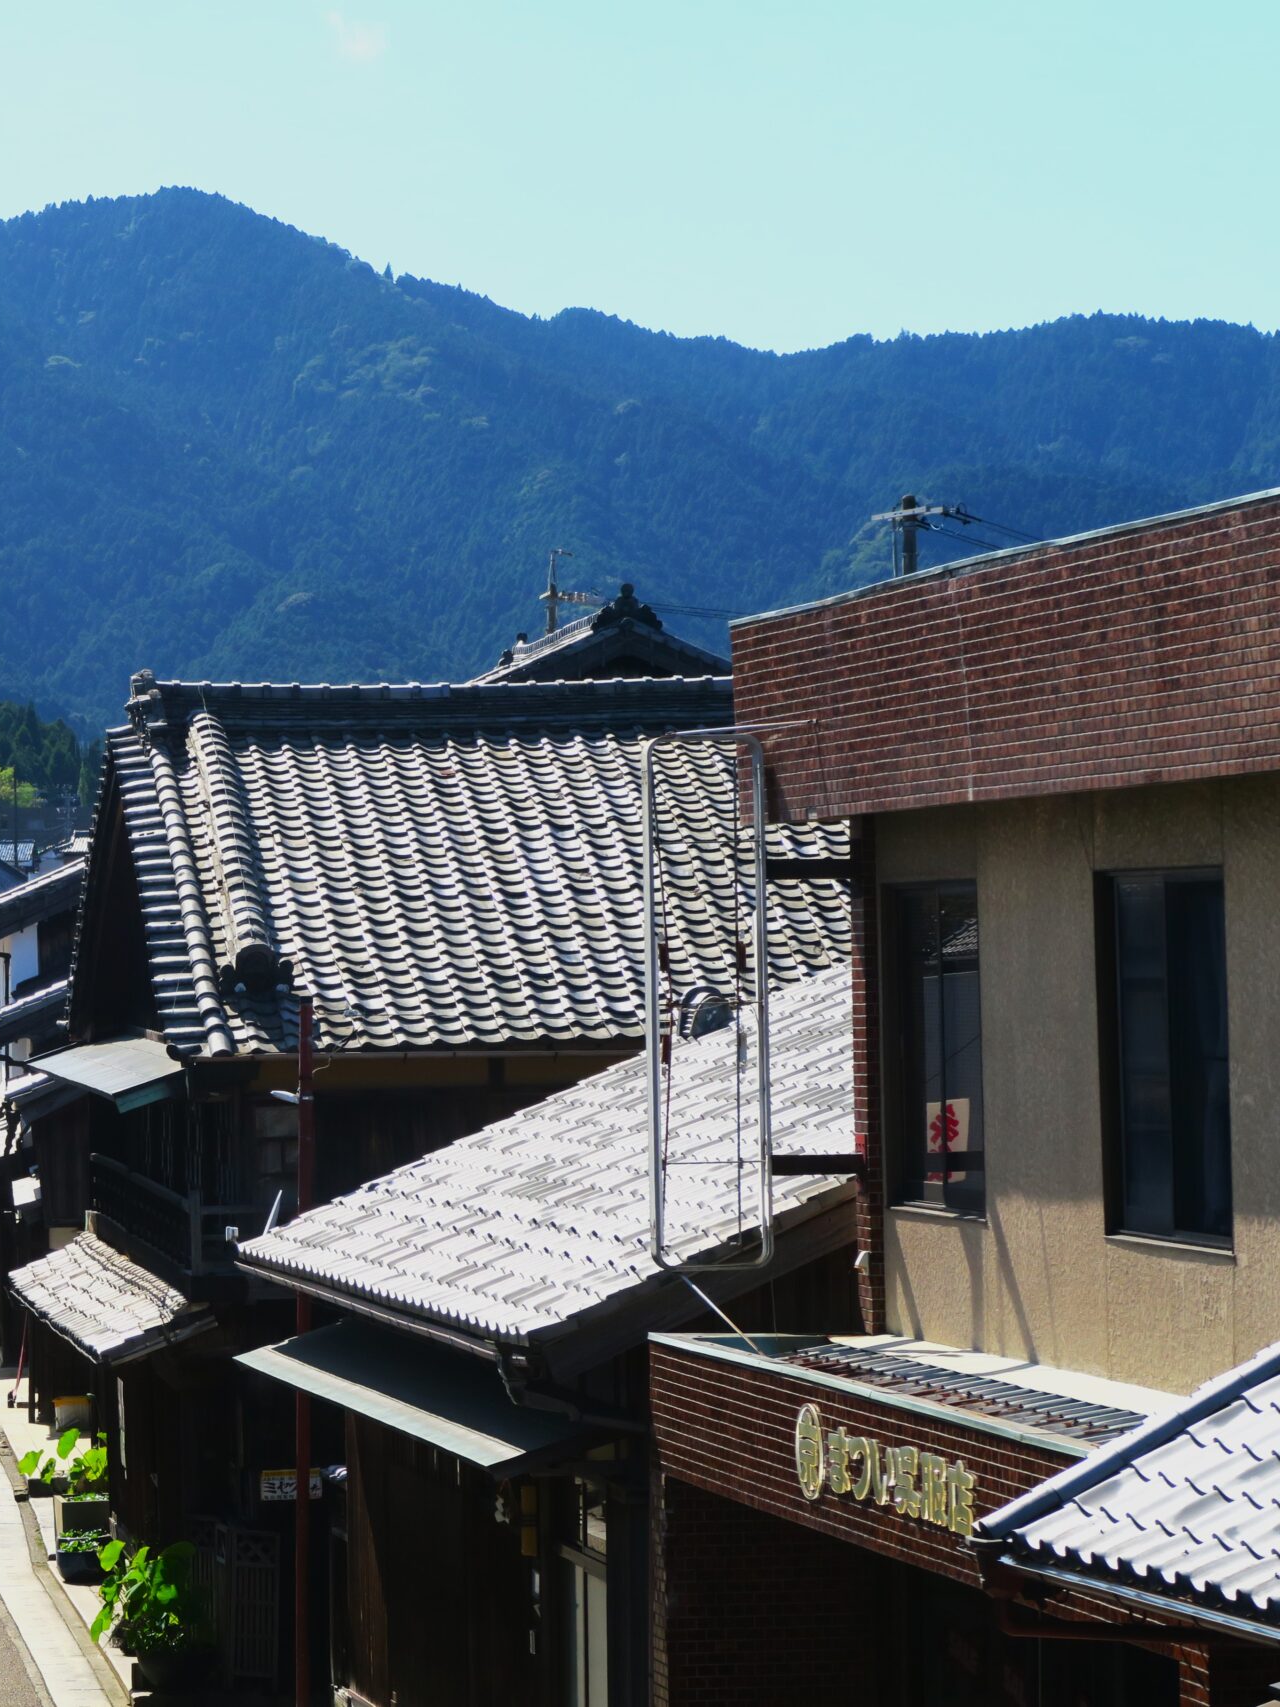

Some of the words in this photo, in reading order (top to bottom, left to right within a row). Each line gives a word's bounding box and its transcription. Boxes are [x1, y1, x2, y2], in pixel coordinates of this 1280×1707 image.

[827, 1426, 975, 1537] まつい呉服店
